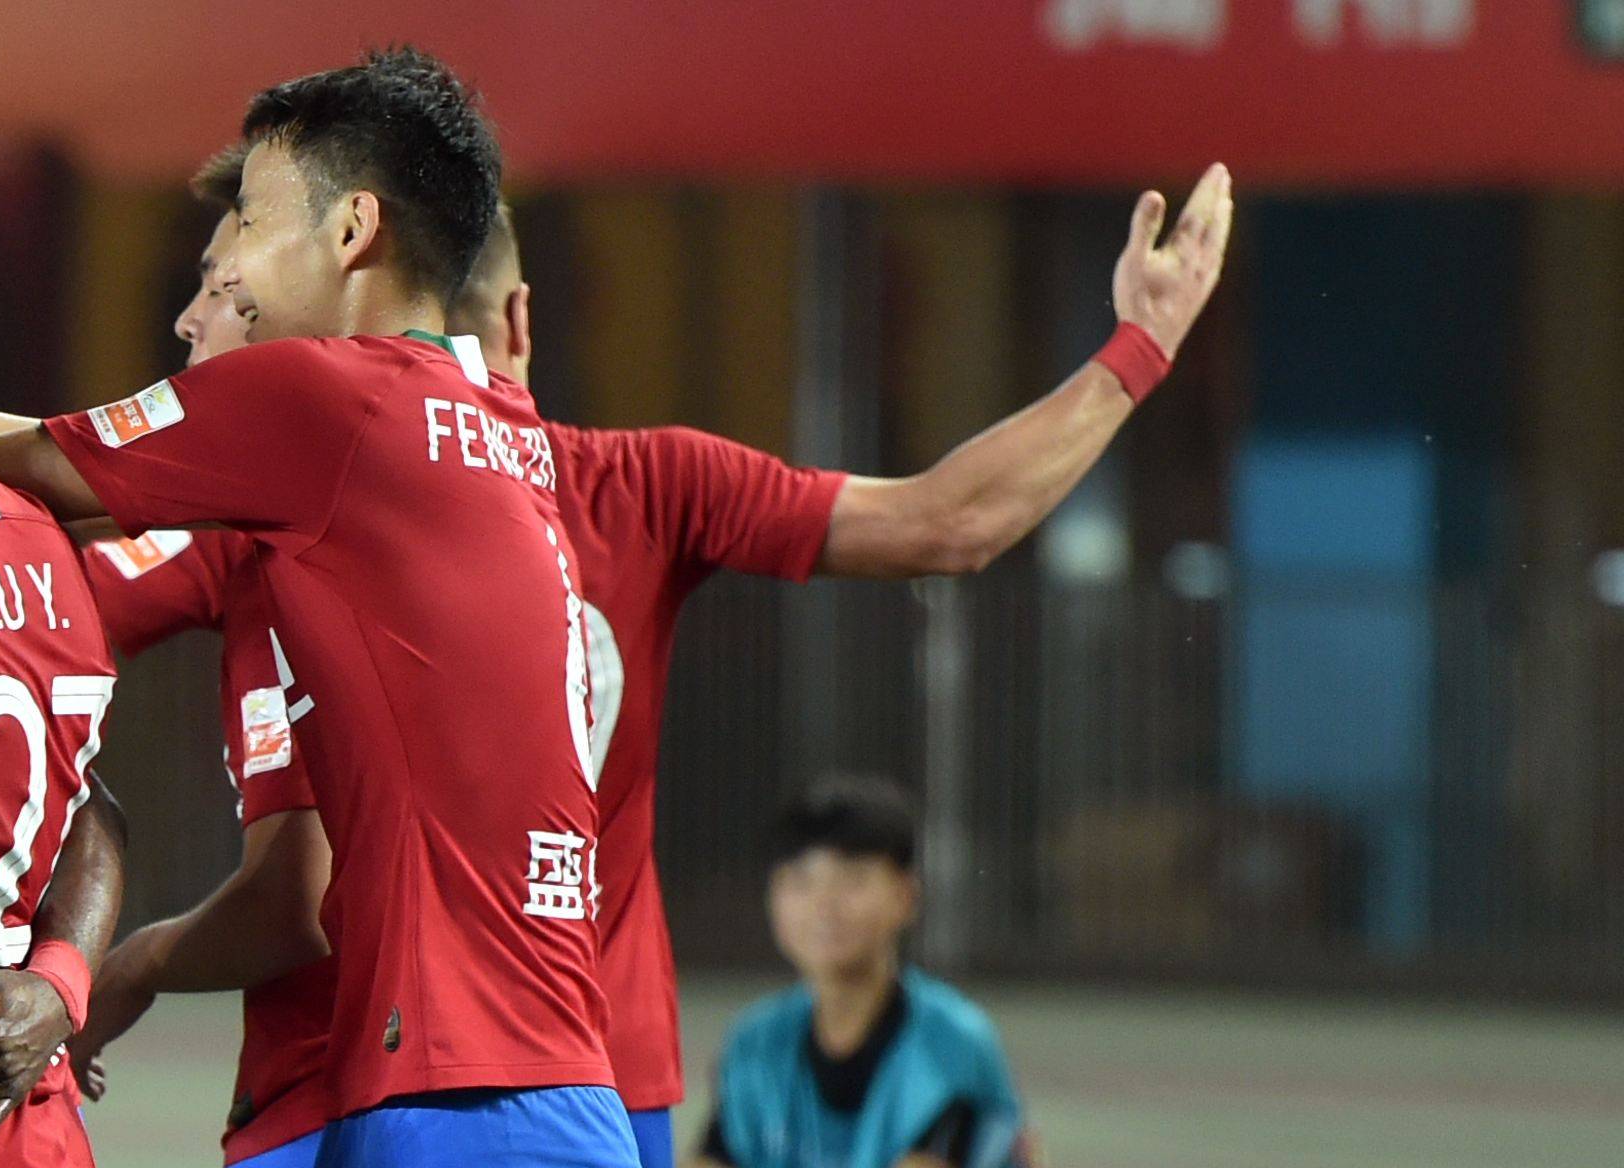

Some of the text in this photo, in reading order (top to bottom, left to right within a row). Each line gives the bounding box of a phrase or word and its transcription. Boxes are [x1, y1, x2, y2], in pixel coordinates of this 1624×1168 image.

[424, 397, 525, 481] FENG
[25, 562, 70, 631] Y.
[522, 829, 602, 923] 盛
